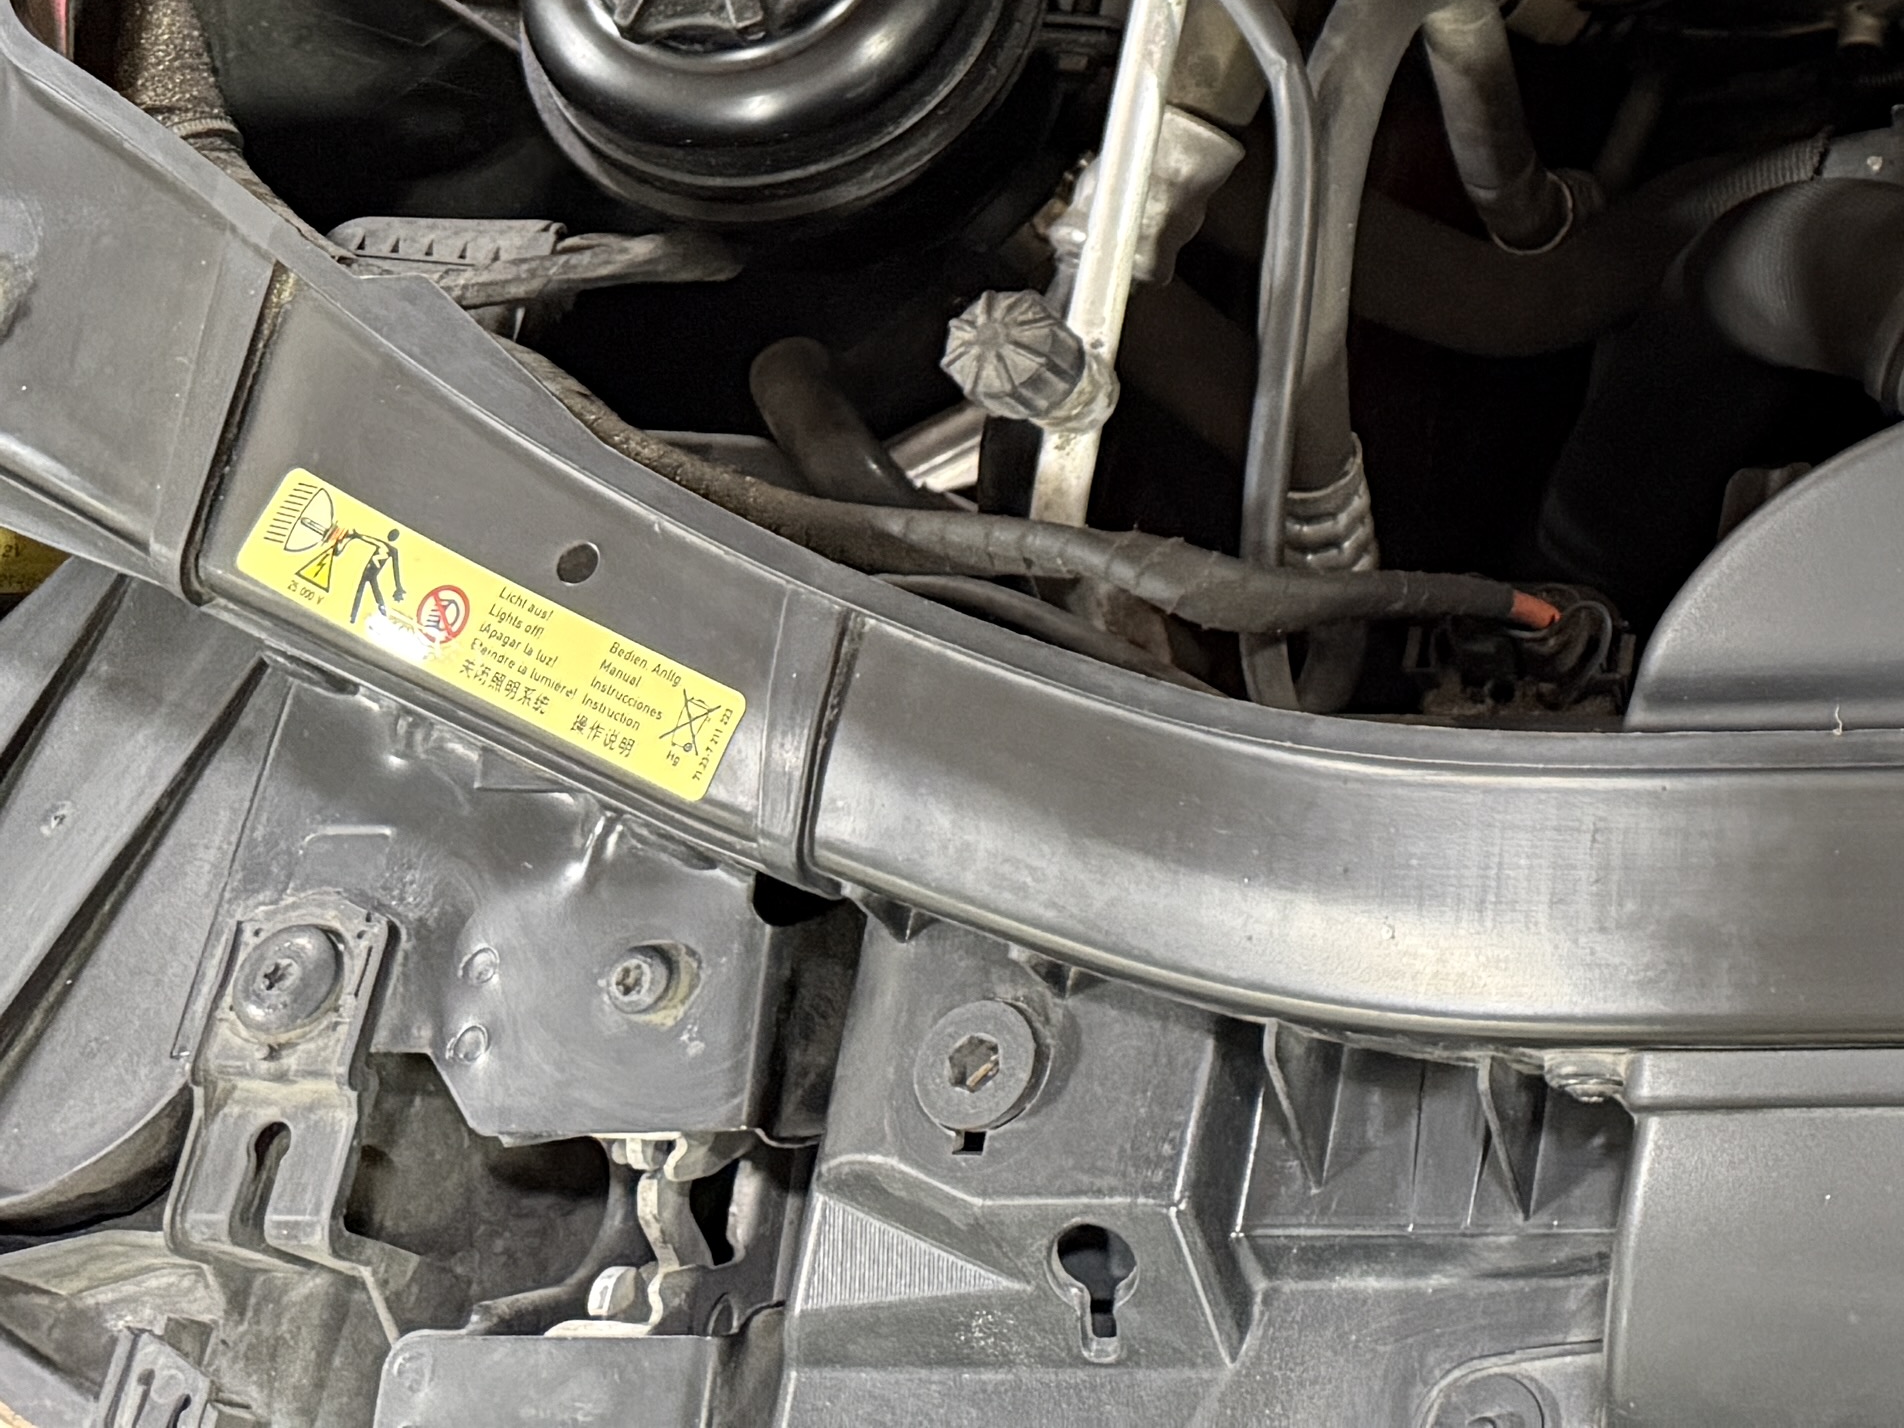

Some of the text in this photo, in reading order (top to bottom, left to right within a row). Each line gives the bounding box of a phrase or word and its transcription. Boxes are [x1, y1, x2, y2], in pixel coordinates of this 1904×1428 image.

[498, 585, 554, 619] Licht aus!
[487, 602, 544, 637] Lights off!
[522, 641, 533, 656] la
[534, 648, 558, 667] luz!
[598, 658, 642, 687] Manual
[580, 692, 640, 731] Instruction
[589, 675, 662, 720] Instrucciones
[569, 713, 635, 758] 操作说明
[665, 749, 680, 766] Hg
